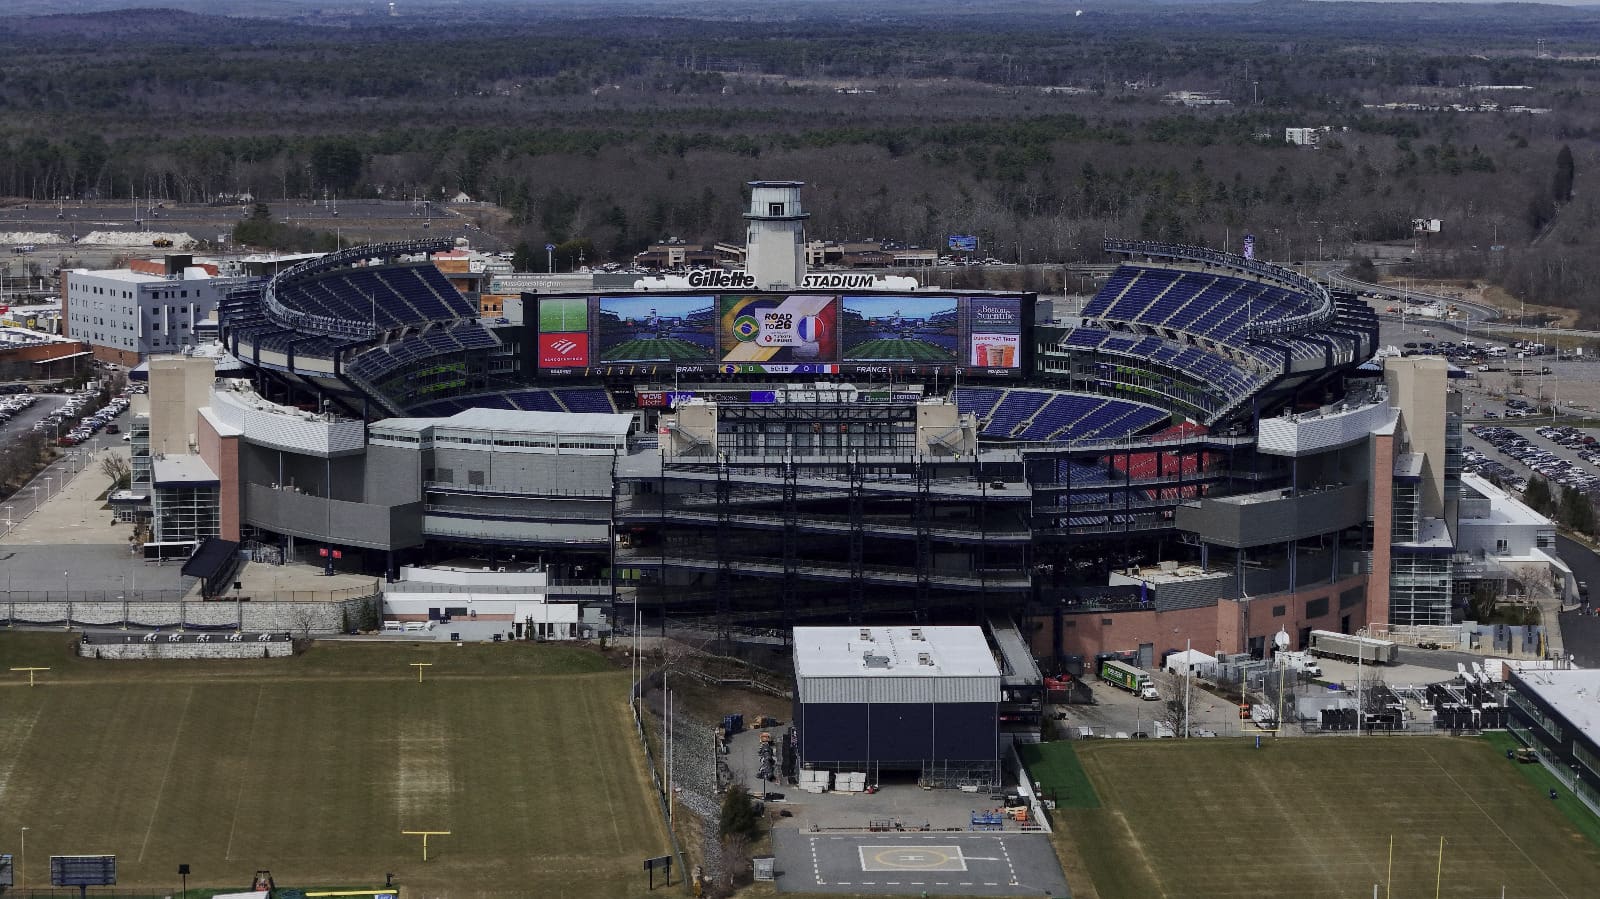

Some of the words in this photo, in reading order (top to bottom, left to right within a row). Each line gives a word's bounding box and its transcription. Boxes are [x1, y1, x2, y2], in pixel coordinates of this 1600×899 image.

[688, 271, 755, 288] Gillette
[802, 275, 873, 288] STADIUM
[765, 313, 793, 321] ROAD
[775, 320, 793, 330] 26
[856, 366, 888, 374] FRANCE
